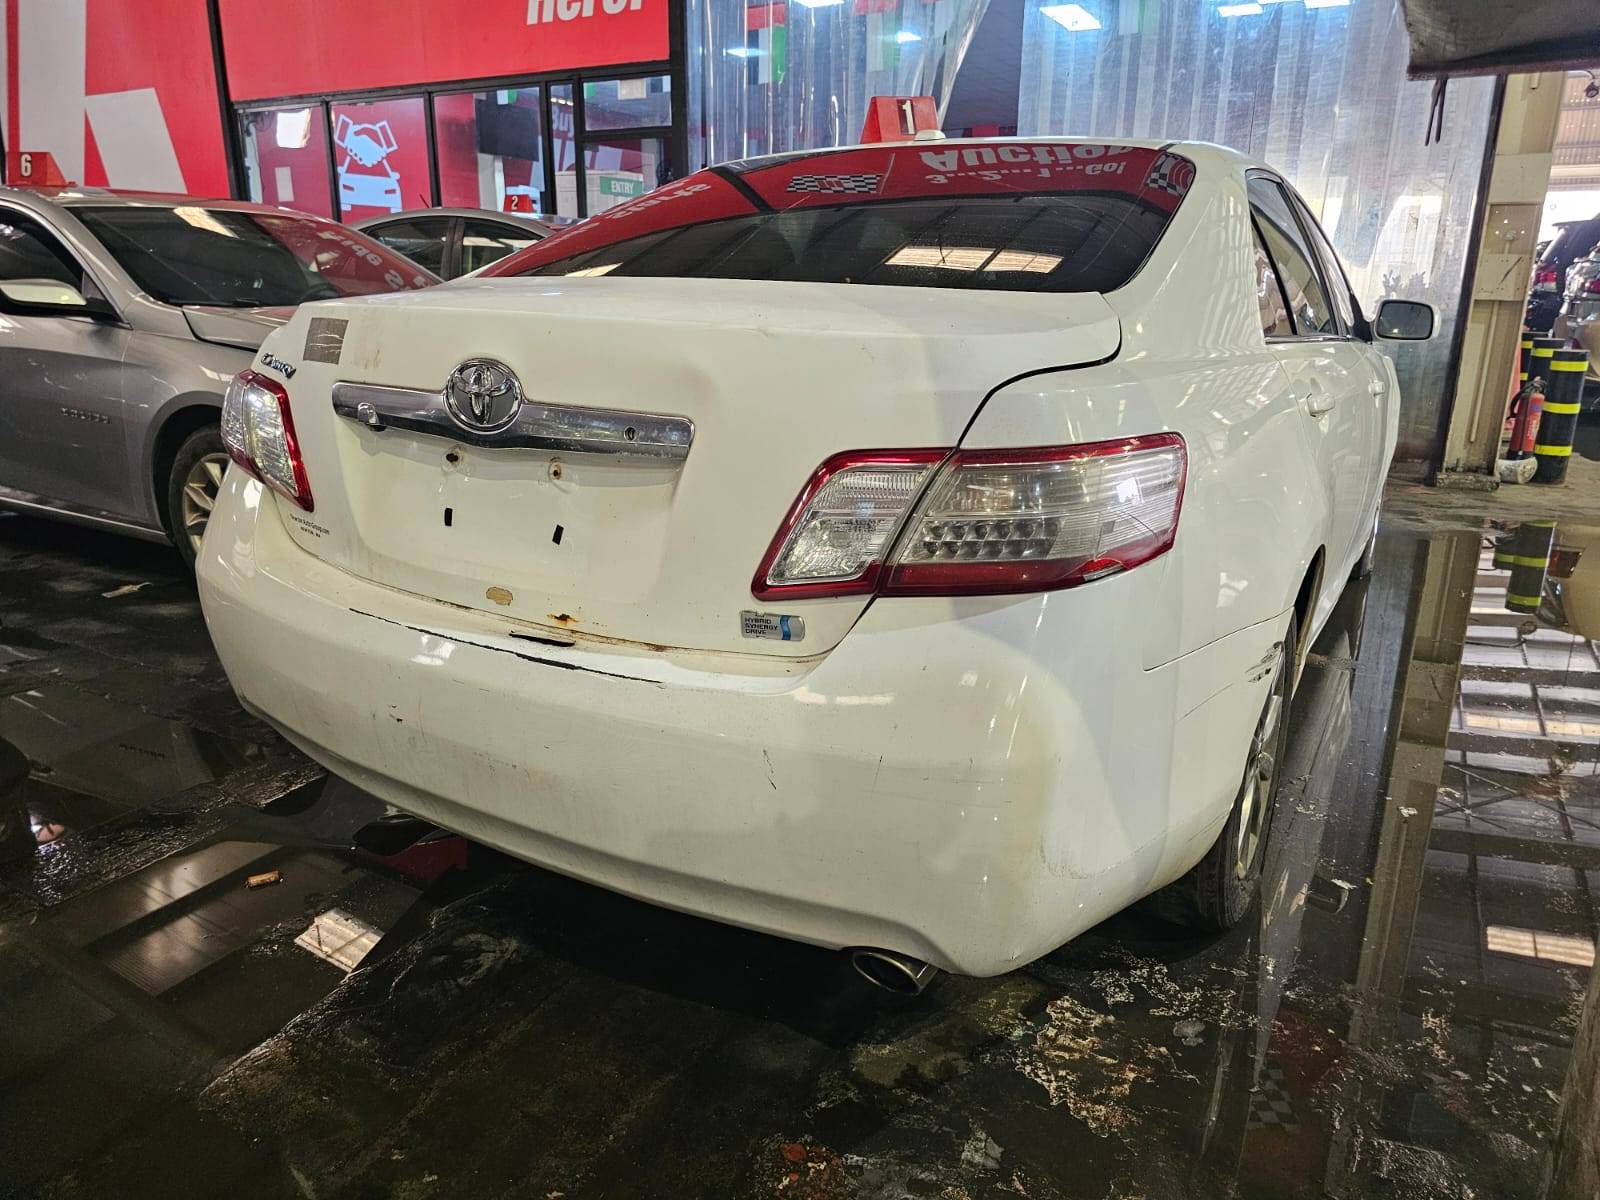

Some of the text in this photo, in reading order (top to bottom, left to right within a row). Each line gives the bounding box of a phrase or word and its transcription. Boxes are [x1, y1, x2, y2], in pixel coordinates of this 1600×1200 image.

[902, 99, 916, 135] 1
[20, 153, 32, 177] 6
[611, 180, 634, 195] ENTRY
[511, 195, 518, 211] 2
[744, 617, 772, 625] HYBRID
